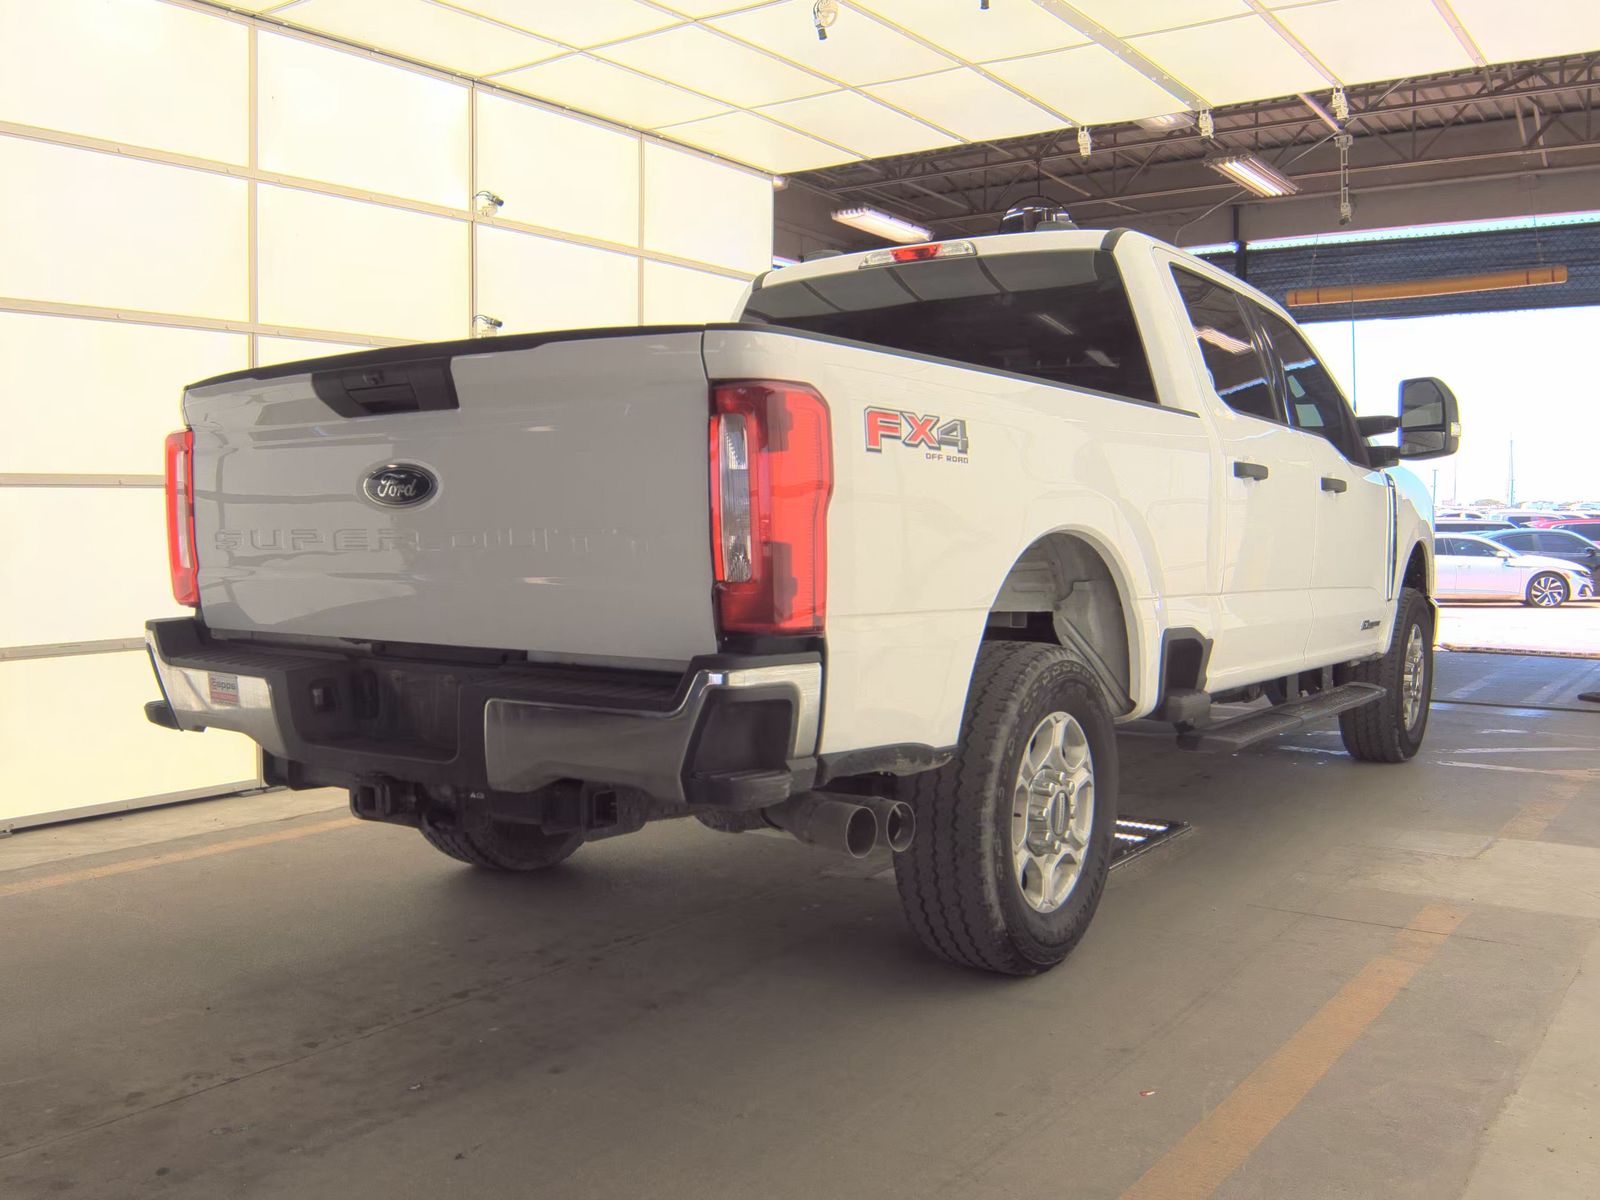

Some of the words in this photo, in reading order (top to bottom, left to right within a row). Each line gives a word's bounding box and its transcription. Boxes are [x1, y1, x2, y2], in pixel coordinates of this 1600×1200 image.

[864, 405, 969, 453] FX4
[925, 453, 943, 461] OFF
[946, 455, 969, 464] ROAD
[377, 473, 417, 497] Ford
[214, 528, 421, 552] SUPER
